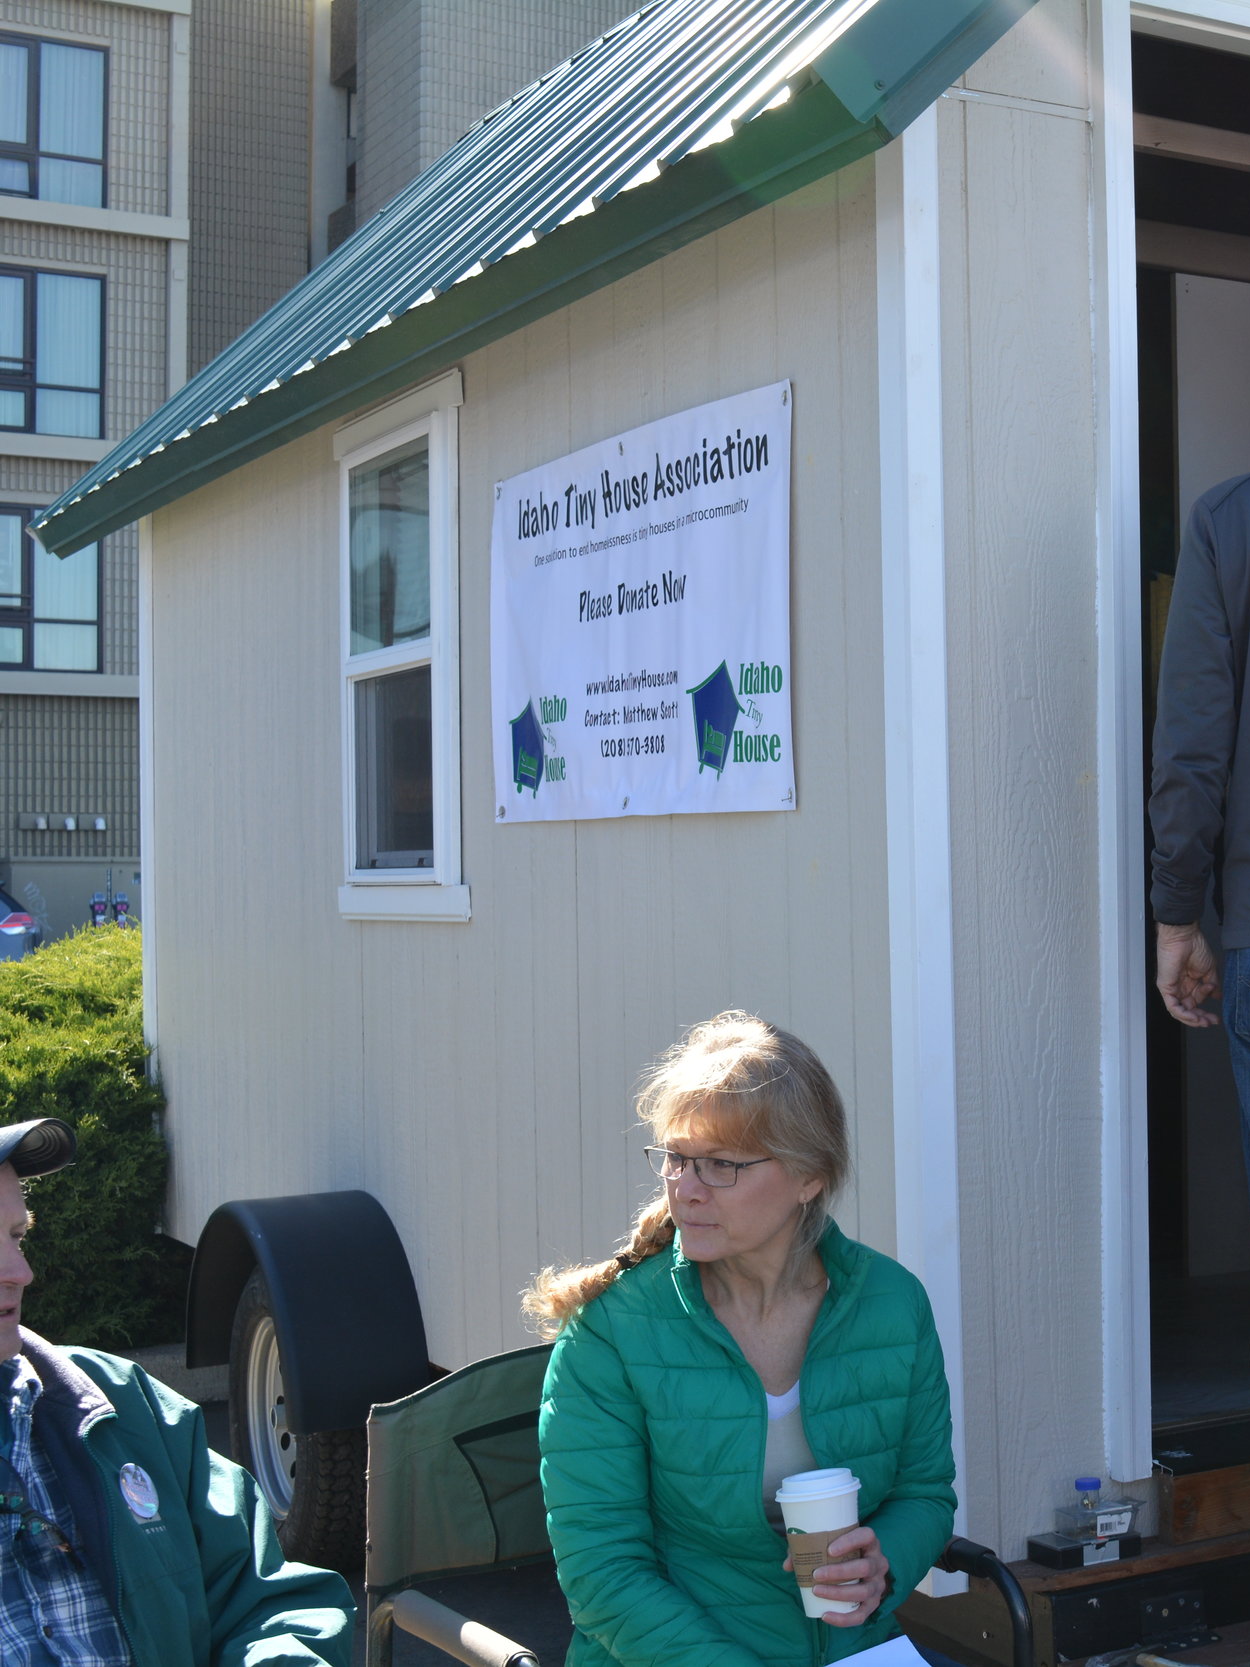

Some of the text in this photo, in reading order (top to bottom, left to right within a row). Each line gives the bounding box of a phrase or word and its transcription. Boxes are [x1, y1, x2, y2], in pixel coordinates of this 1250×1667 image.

[518, 428, 769, 541] Idaho Tiny House Association
[534, 555, 545, 567] One
[569, 547, 577, 559] to
[578, 543, 589, 557] end
[632, 529, 638, 541] is
[649, 520, 676, 536] houses
[685, 497, 749, 525] microcommunity
[579, 570, 687, 622] Please Donate Now
[738, 661, 783, 695] Idaho
[539, 695, 567, 725] Idaho
[584, 700, 678, 727] Contact: Matthew Scott
[745, 699, 763, 729] Tiny
[733, 730, 781, 763] House
